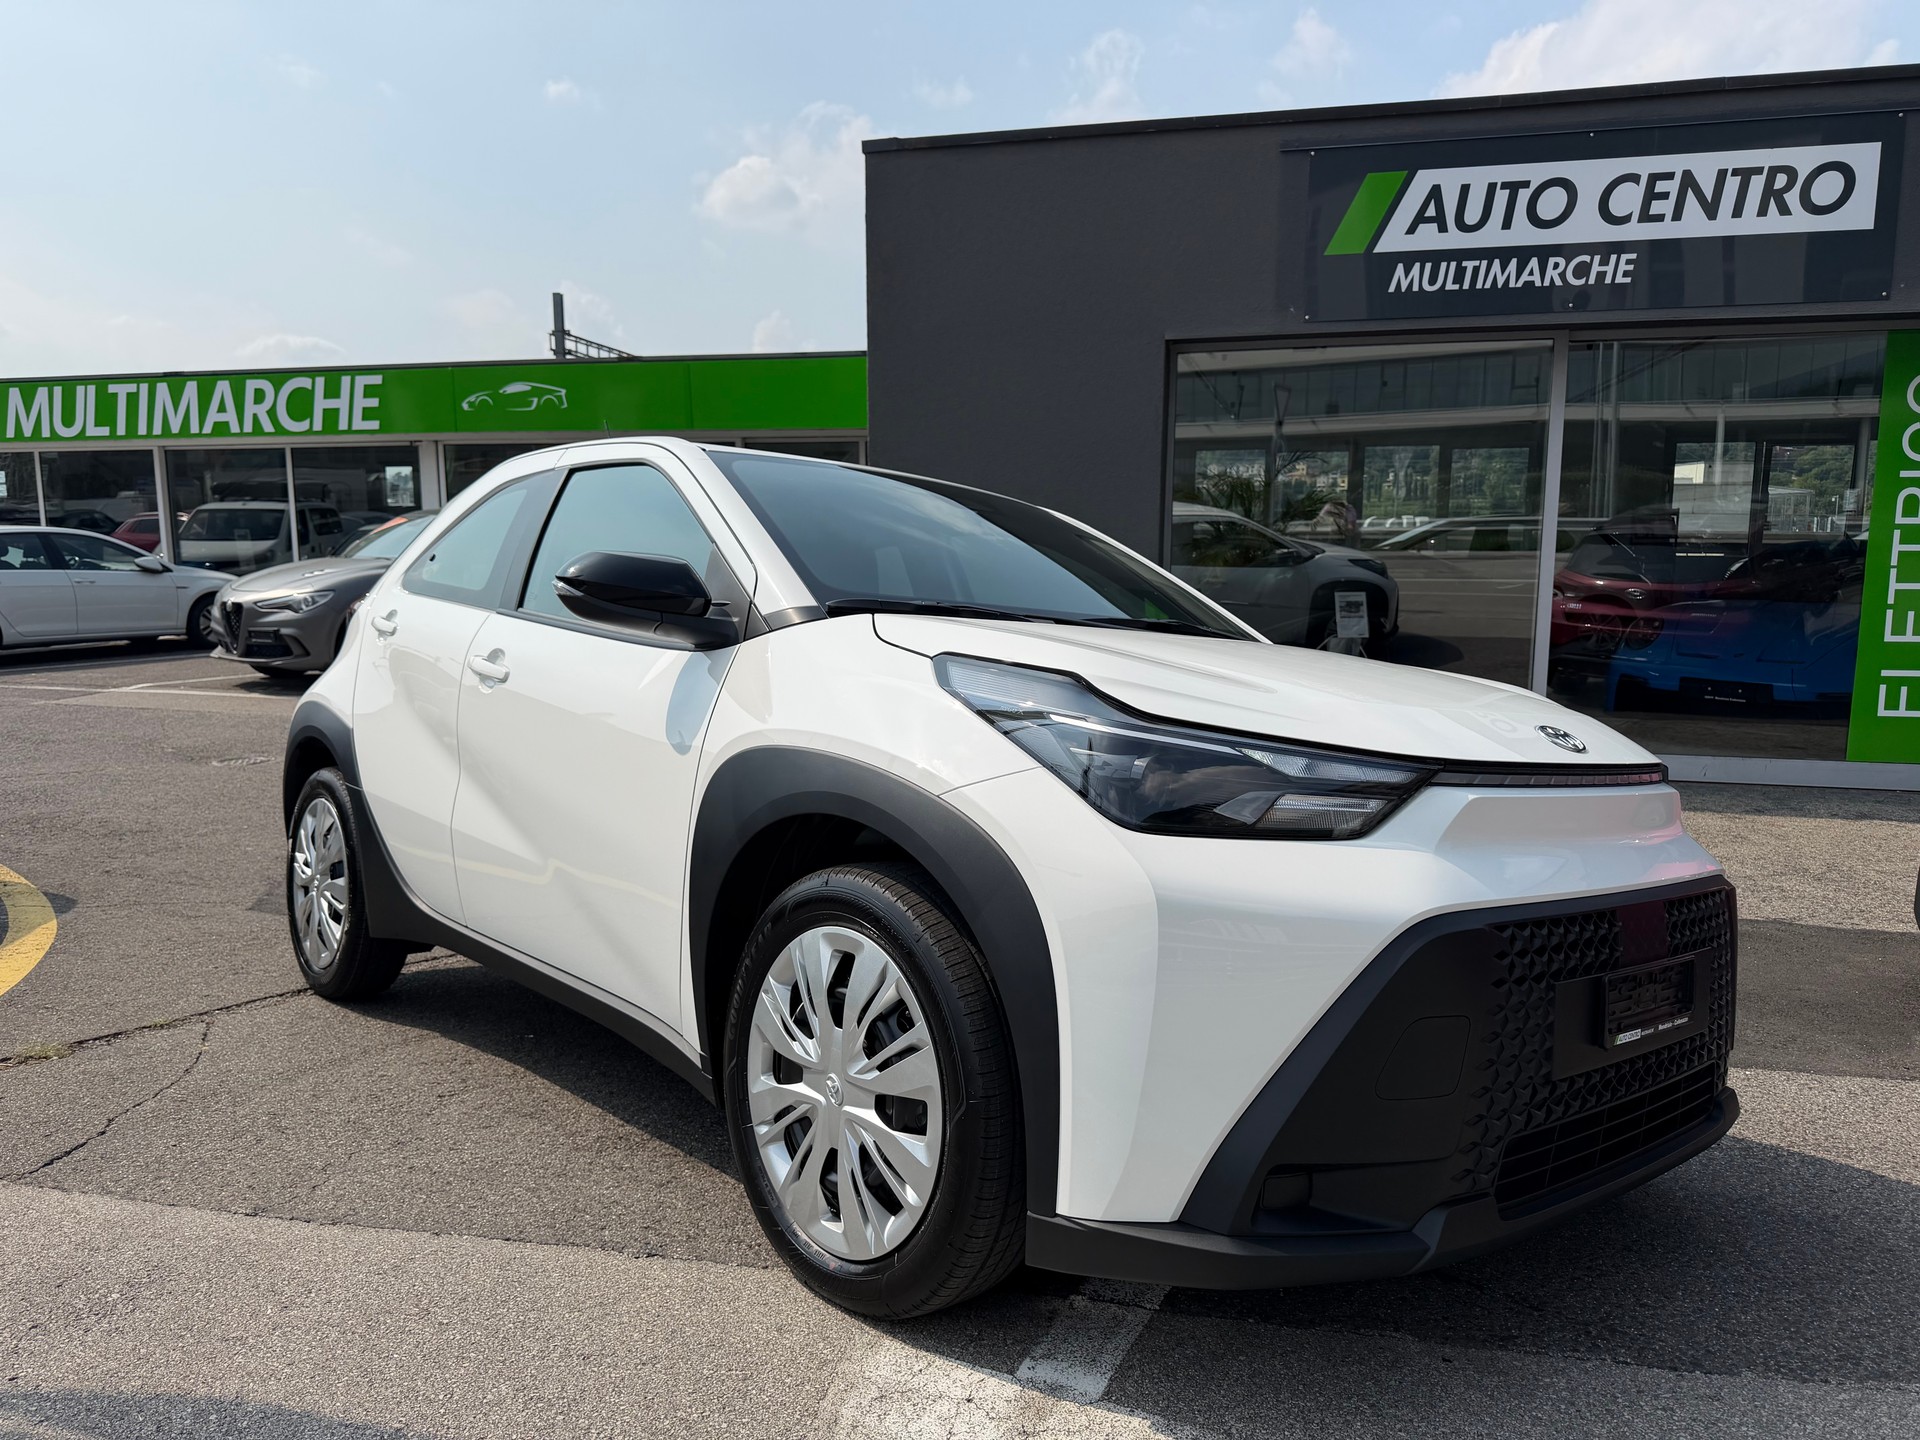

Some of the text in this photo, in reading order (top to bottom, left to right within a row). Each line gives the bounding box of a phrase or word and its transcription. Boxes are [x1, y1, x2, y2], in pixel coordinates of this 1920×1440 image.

[1405, 160, 1857, 236] AUTO CENTRO
[1387, 253, 1638, 294] MULTIMARCHE
[5, 374, 383, 438] MULTIMARCHE
